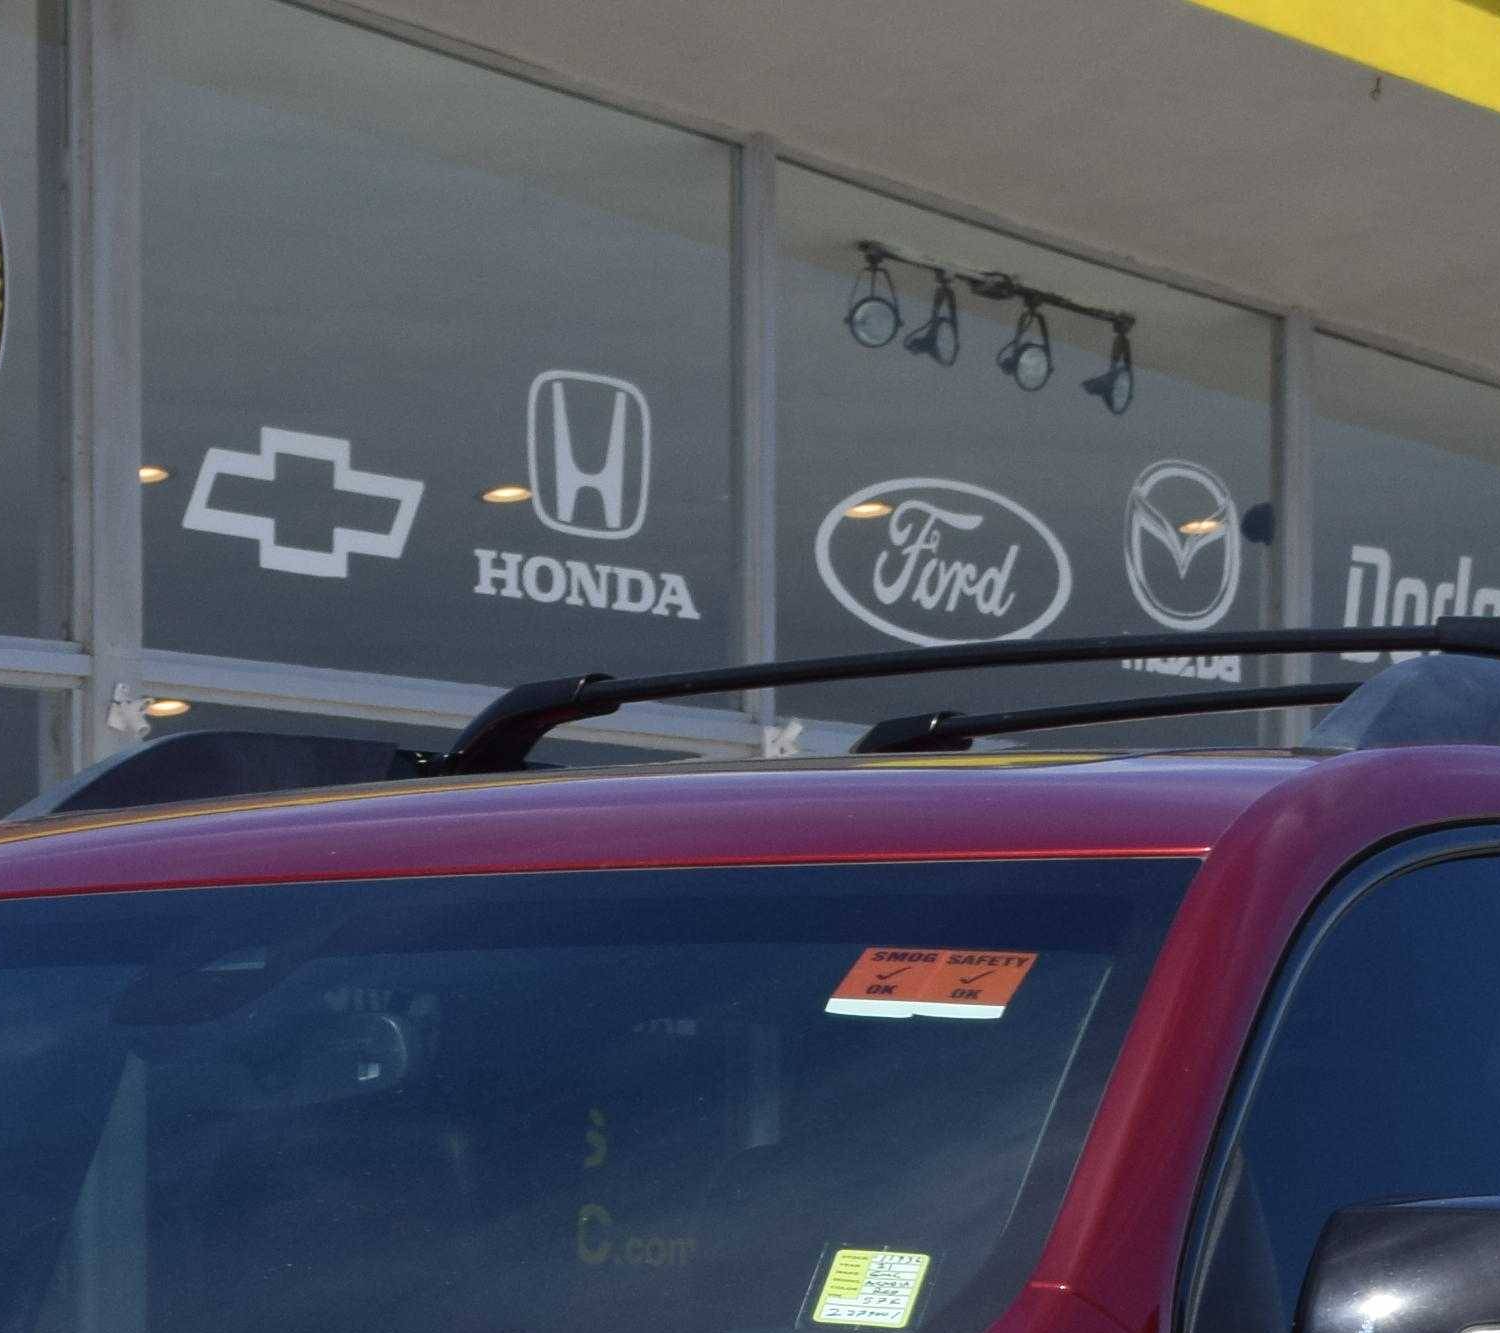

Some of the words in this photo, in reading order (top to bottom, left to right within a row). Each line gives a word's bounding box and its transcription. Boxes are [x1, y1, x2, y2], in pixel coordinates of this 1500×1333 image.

[871, 497, 1020, 618] Ford
[472, 548, 701, 620] HONDA
[871, 950, 938, 964] SMOG
[946, 953, 1030, 968] SAFETY
[865, 984, 898, 996] OK
[949, 988, 984, 1001] OK
